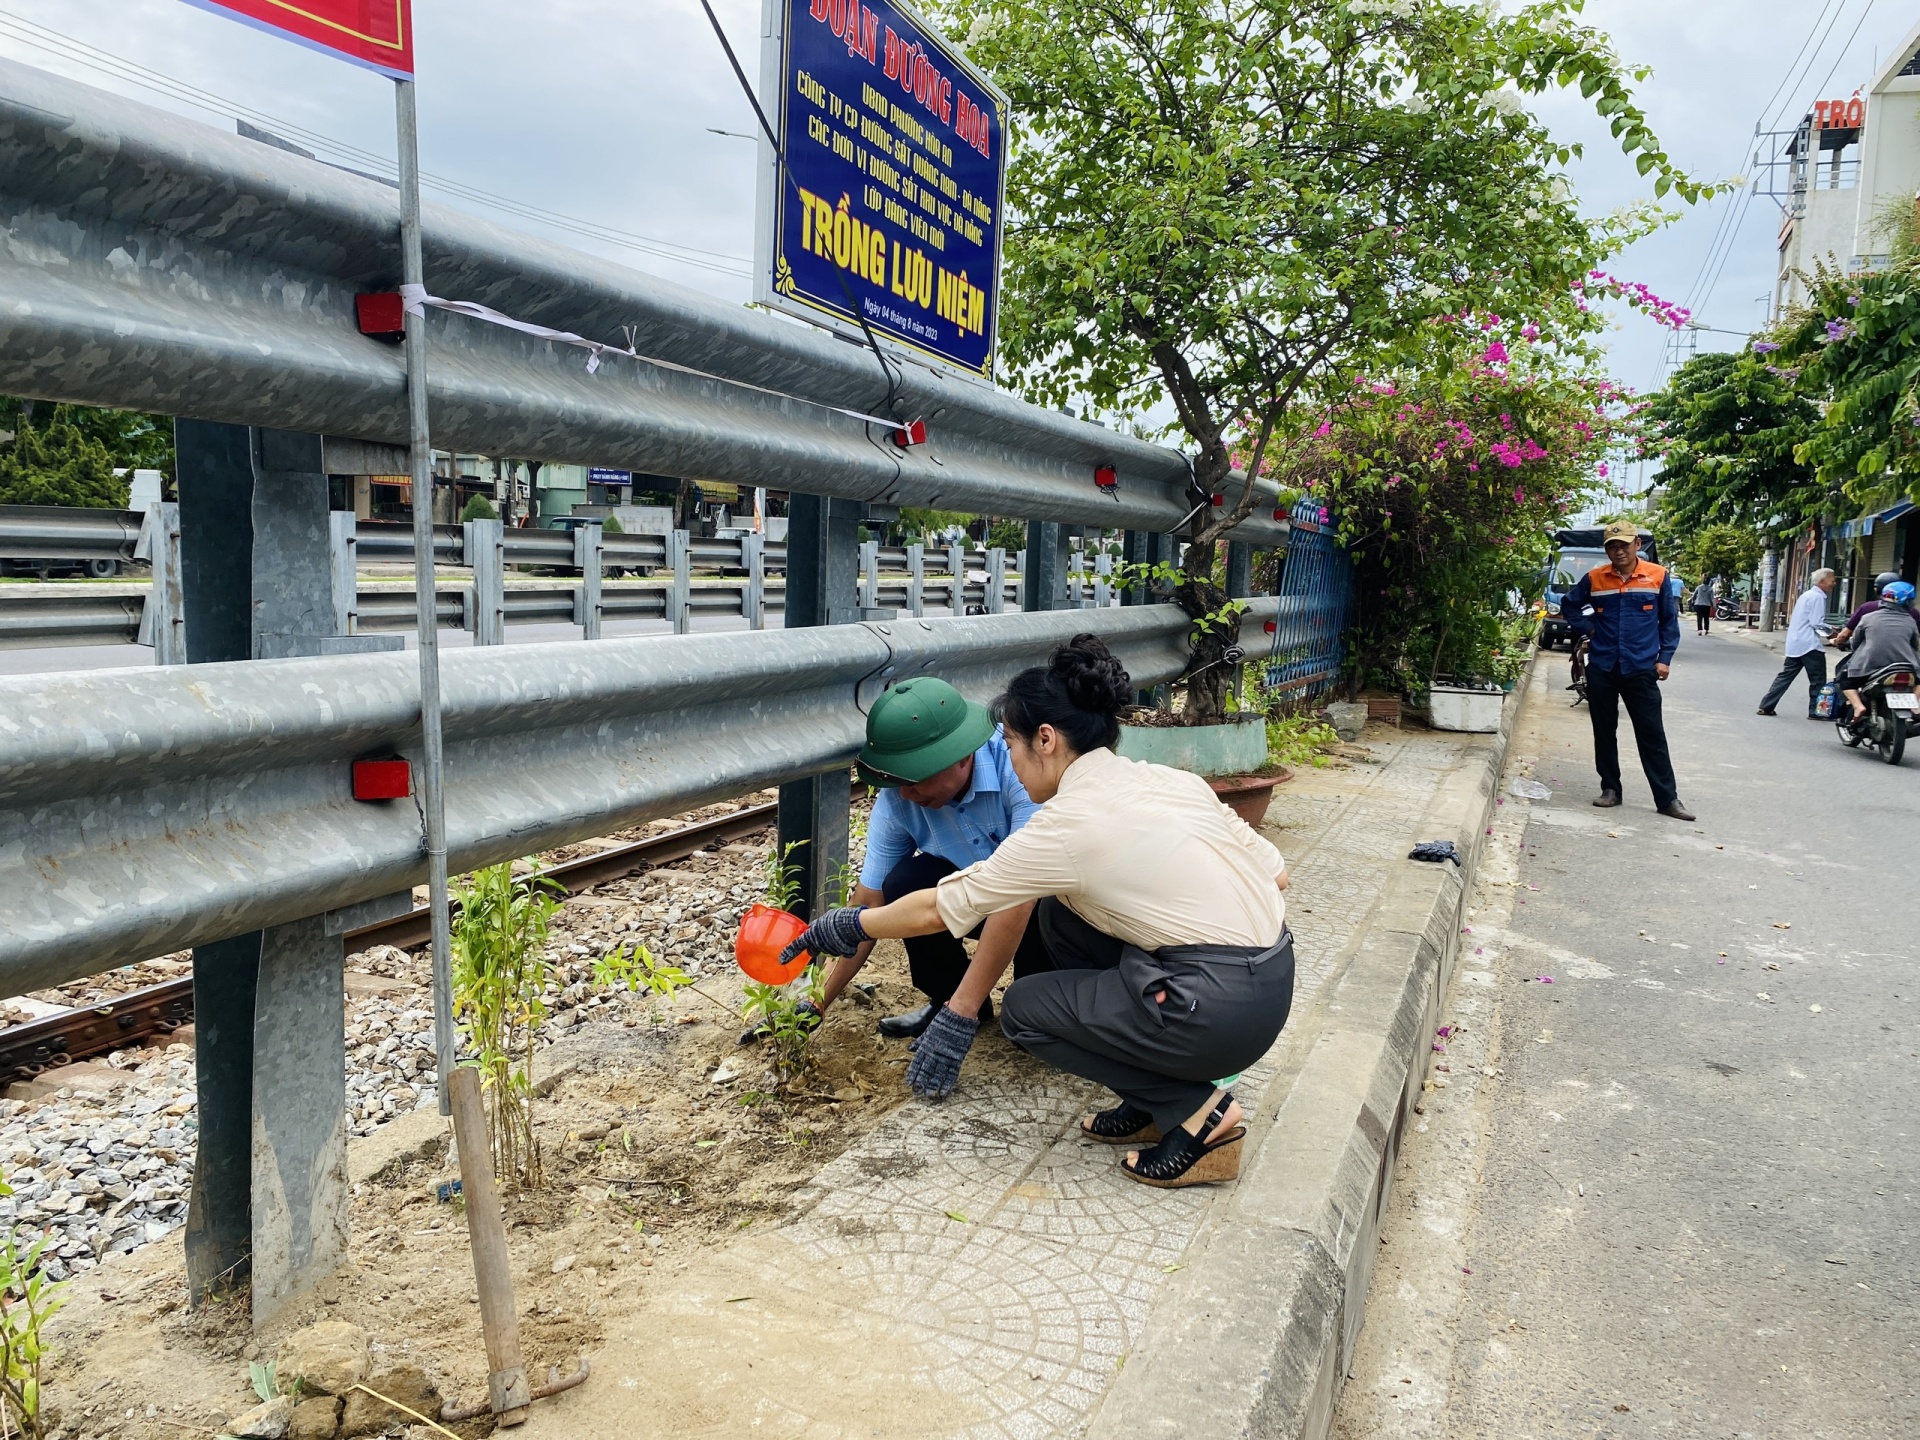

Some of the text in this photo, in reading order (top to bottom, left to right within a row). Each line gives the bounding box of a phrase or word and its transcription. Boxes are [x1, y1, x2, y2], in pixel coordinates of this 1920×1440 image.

[797, 69, 826, 109] CÔNG
[829, 91, 842, 120] TY
[844, 103, 858, 130] CP
[860, 115, 893, 155] ĐƯỜNG
[894, 138, 912, 168] SẮT
[913, 152, 939, 188] QUẢNG
[940, 172, 958, 201] NAM
[962, 189, 973, 212] ĐÀ
[862, 82, 953, 168] UBND PHƯỜNG HÒA AN
[883, 25, 952, 127] ĐƯỜNG
[955, 90, 990, 160] HOA
[808, 114, 830, 148] CÁC
[832, 130, 854, 163] ĐƠN
[856, 145, 867, 174] VỊ
[869, 154, 900, 193] ĐƯỜNG
[902, 175, 919, 204] SẮT
[919, 188, 936, 216] KHU
[937, 200, 953, 227] VỰC
[953, 212, 964, 235] ĐÀ
[864, 184, 945, 252] LỚP ĐẢNG VIÊN MỚI
[799, 186, 985, 338] TRỒNG LƯU NIỆM
[864, 297, 938, 341] Ngày 04 tháng 8 năm 2023
